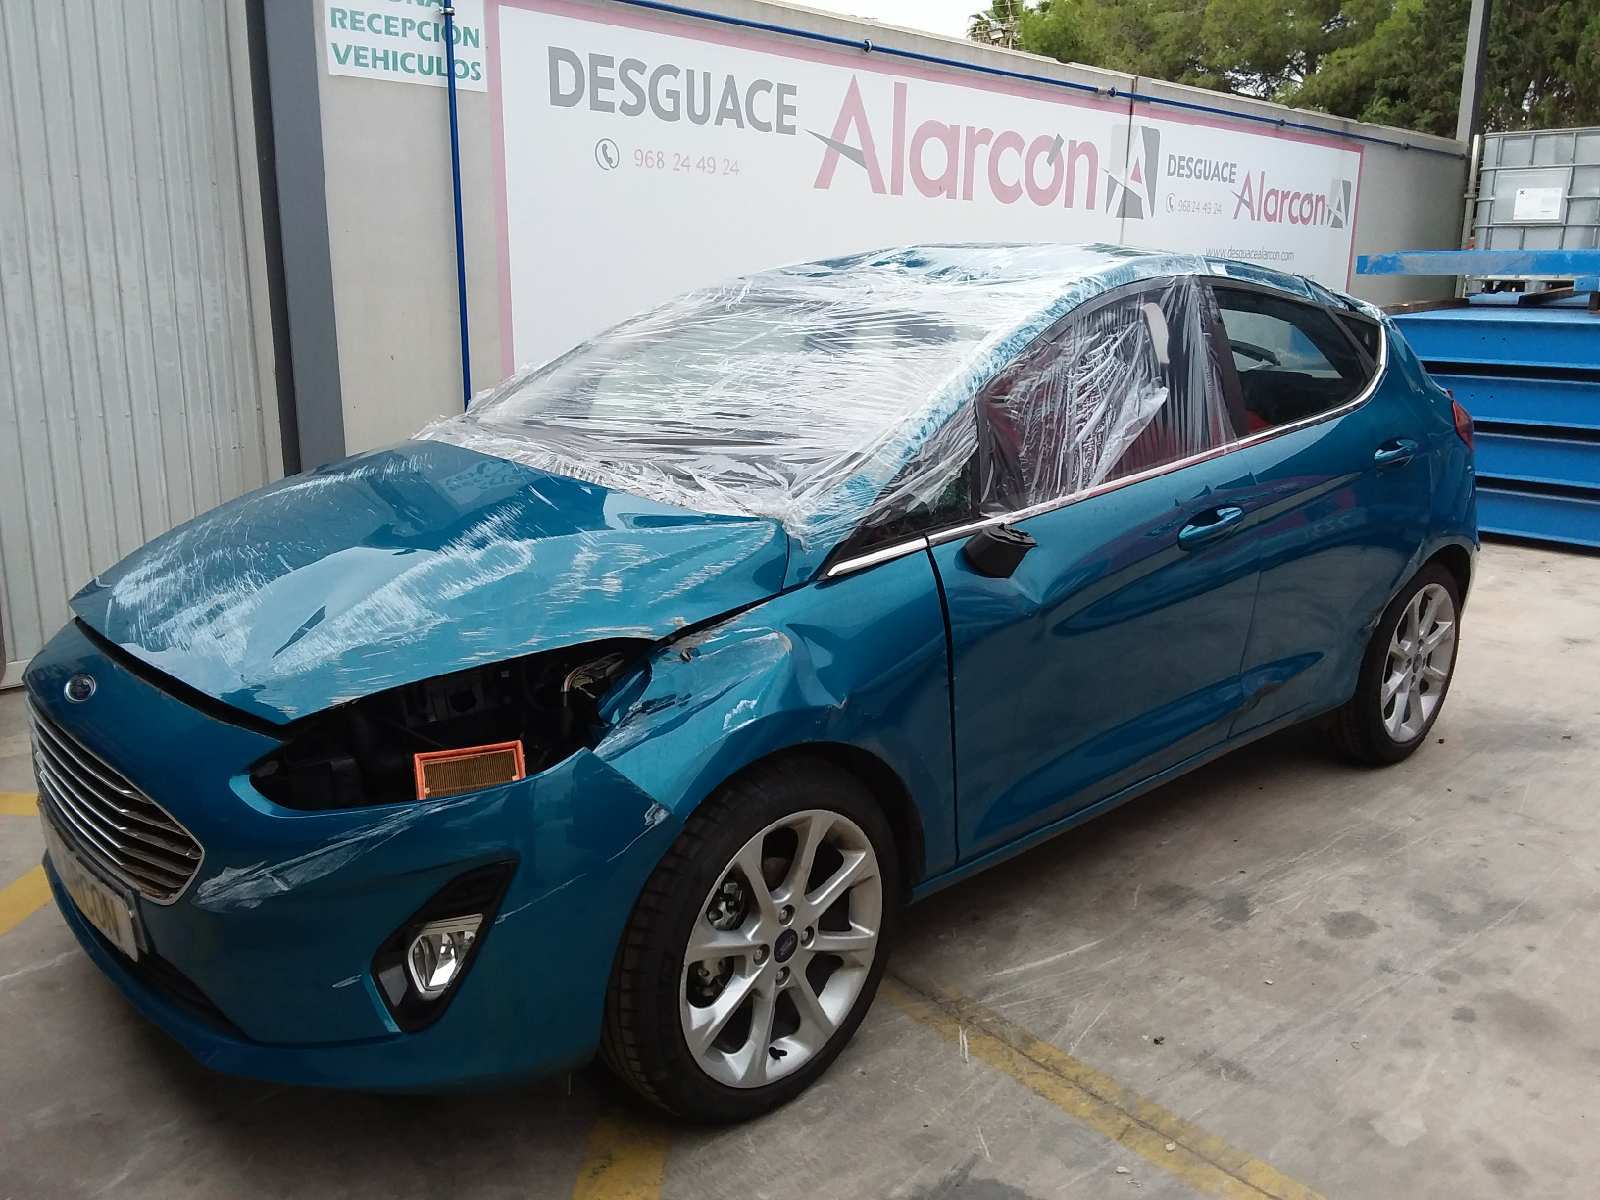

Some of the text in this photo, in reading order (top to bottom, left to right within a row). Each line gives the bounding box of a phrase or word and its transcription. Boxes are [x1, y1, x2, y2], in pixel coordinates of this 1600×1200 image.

[331, 43, 482, 80] VEHICULOS
[548, 46, 797, 135] DESGUACE
[634, 149, 740, 176] 968 24 49 24
[1167, 153, 1237, 184] DESGUACE
